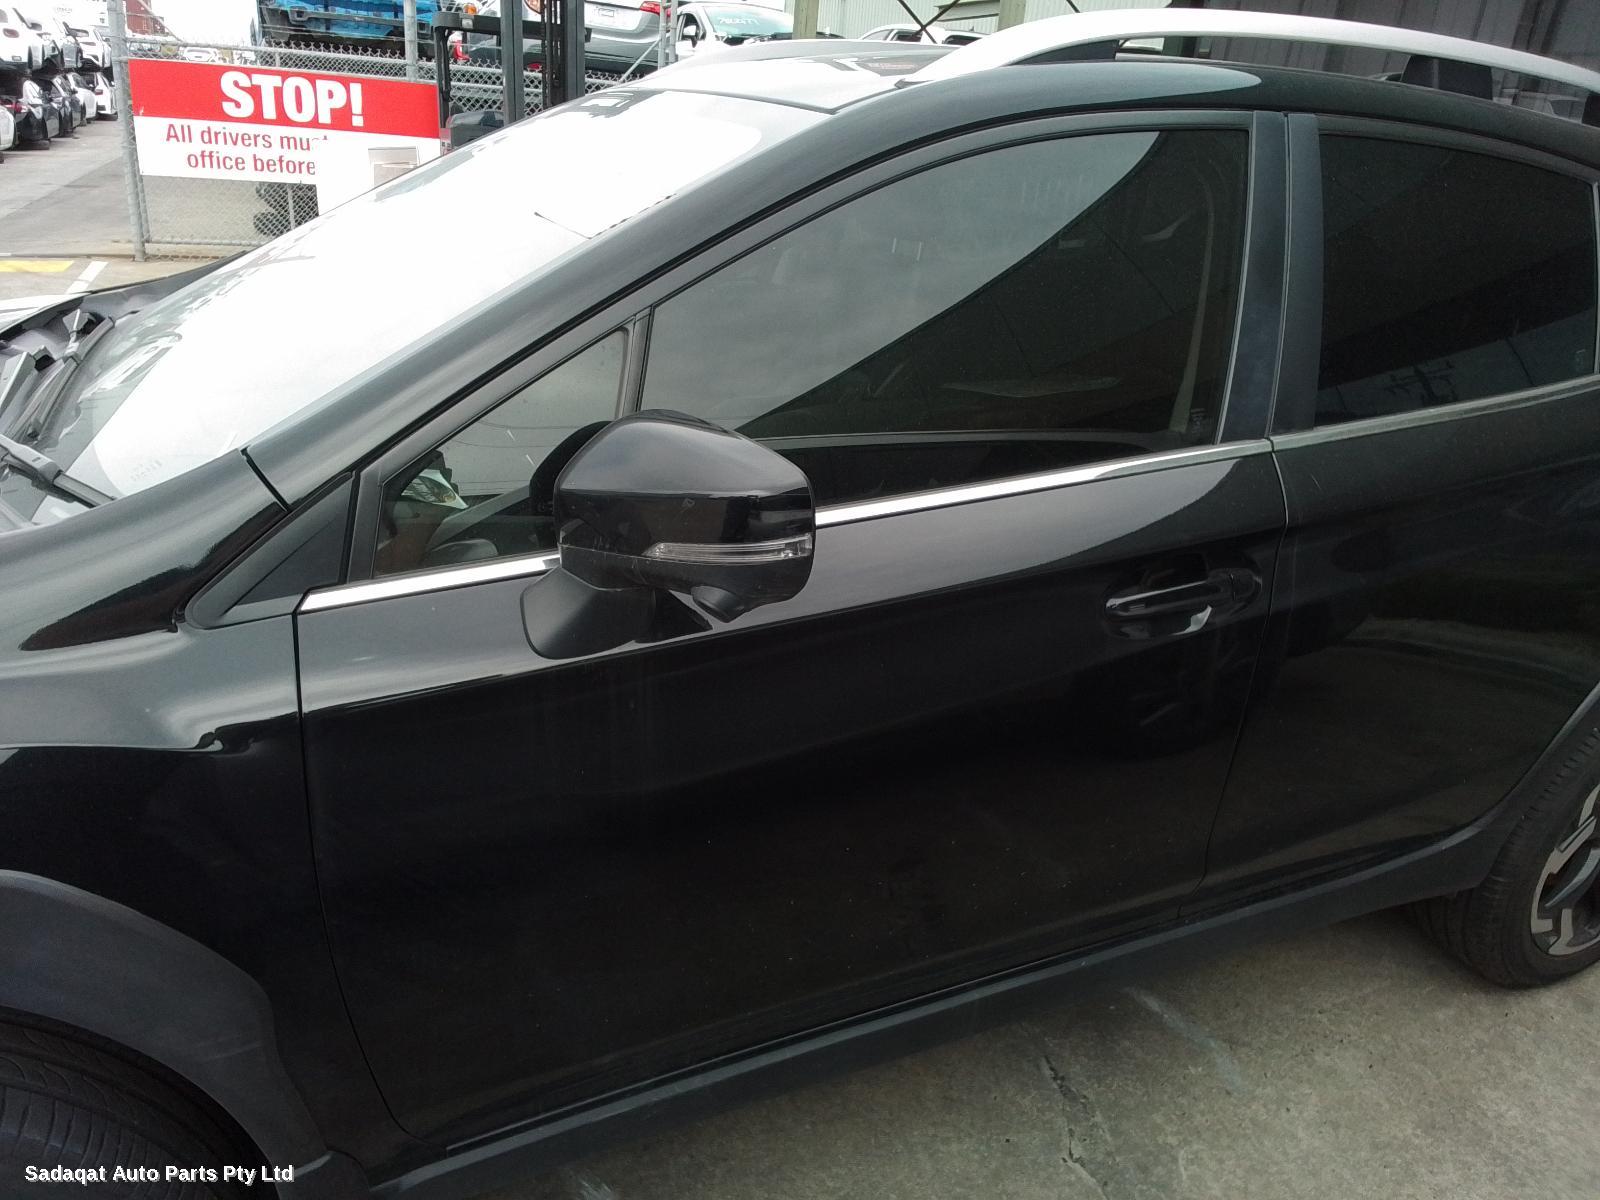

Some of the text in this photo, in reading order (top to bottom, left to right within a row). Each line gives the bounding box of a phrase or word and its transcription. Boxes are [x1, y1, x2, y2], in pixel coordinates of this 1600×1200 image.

[220, 71, 364, 127] STOP!
[166, 124, 328, 152] All drivers mu
[187, 150, 316, 175] office before
